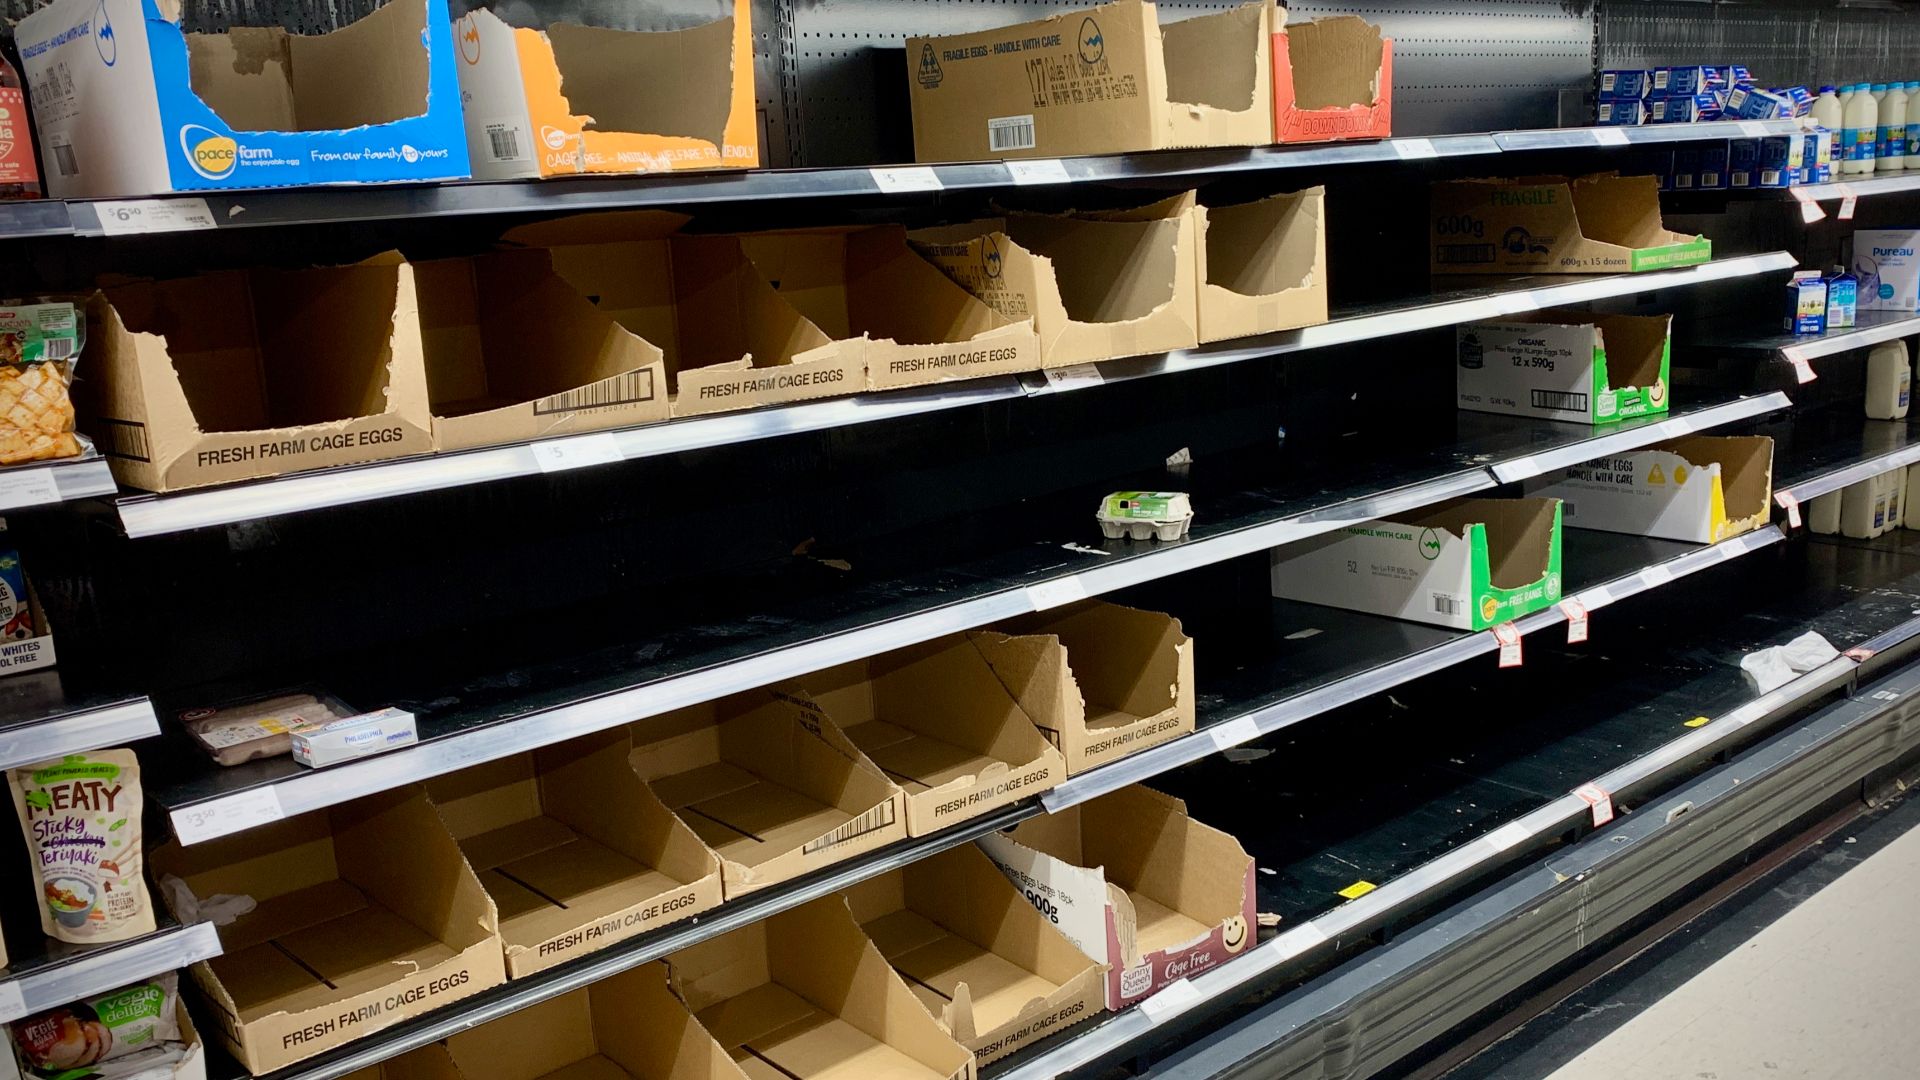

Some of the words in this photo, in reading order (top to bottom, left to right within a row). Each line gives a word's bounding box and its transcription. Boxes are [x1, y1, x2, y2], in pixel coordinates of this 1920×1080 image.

[943, 48, 970, 62] FRAGILE
[971, 45, 988, 57] EGGS
[994, 40, 1021, 55] HANDLE
[1022, 38, 1041, 50] WITH
[1041, 34, 1061, 48] CARE
[1303, 116, 1337, 136] DOWN
[1338, 114, 1373, 134] DOWN
[197, 149, 234, 164] pace
[239, 145, 273, 159] farm
[310, 150, 341, 162] From
[342, 151, 362, 161] our
[363, 147, 402, 162] family
[417, 148, 449, 162] yours
[546, 151, 577, 168] CAGE
[584, 152, 606, 166] REE
[1490, 189, 1556, 206] FRAGILE
[1437, 215, 1484, 238] 600g
[1872, 247, 1914, 257] Pureau
[1560, 257, 1582, 267] 600g
[1591, 257, 1601, 266] 15
[1603, 257, 1627, 266] dozen
[1518, 338, 1546, 347] ORGANIC
[889, 358, 925, 374] FRESH
[927, 354, 956, 369] FARM
[958, 350, 986, 365] CAGE
[989, 347, 1016, 361] EGGS
[1512, 356, 1522, 367] 12
[1523, 359, 1530, 367] x
[1531, 357, 1555, 372] 590g
[700, 382, 740, 399] FRESH
[743, 378, 775, 394] FARM
[778, 373, 810, 389] CAGE
[812, 369, 844, 384] EGGS
[1618, 404, 1647, 416] ORGANIC
[197, 446, 254, 468] FRESH
[259, 439, 305, 458] FARM
[310, 433, 355, 452] CAGE
[359, 427, 403, 446] EGGS
[1614, 460, 1633, 472] EGGS
[1567, 469, 1592, 481] HANDLE
[1596, 472, 1613, 483] WITH
[1616, 474, 1633, 485] CARE
[1348, 527, 1374, 536] HANDLE
[1375, 530, 1394, 538] WITH
[1395, 532, 1413, 540] CARE
[1509, 593, 1524, 606] FREE
[1525, 587, 1543, 602] RANGE
[2, 641, 41, 657] WHITES
[14, 652, 37, 666] FREE
[1085, 740, 1111, 757] FRESH
[1112, 732, 1135, 748] FARM
[1136, 724, 1157, 739] CAGE
[1158, 717, 1180, 732] EGGS
[25, 781, 122, 820] MEATY
[935, 797, 967, 817] FRESH
[968, 787, 995, 806] FARM
[996, 778, 1022, 795] CAGE
[1023, 768, 1049, 786] EGGS
[33, 815, 84, 842] Sticky
[39, 848, 98, 867] Teriyaki
[1020, 871, 1036, 889] Eggs
[1037, 879, 1056, 898] Large
[1026, 890, 1058, 924] 900g
[539, 932, 583, 957] FRESH
[586, 920, 621, 940] FARM
[624, 906, 659, 927] CAGE
[662, 893, 696, 914] EGGS
[1123, 966, 1150, 980] Sunny
[1165, 959, 1189, 979] Cage
[1189, 951, 1211, 969] Free
[1122, 974, 1151, 992] Queen
[282, 1020, 335, 1050] FRESH
[339, 1002, 381, 1029] FARM
[384, 986, 426, 1011] CAGE
[429, 970, 470, 996] EGGS
[25, 1018, 59, 1041] VEGIE
[974, 1040, 1003, 1060] FRESH
[1004, 1027, 1031, 1047] FARM
[1032, 1013, 1058, 1033] CAGE
[1059, 1000, 1085, 1021] EGGS
